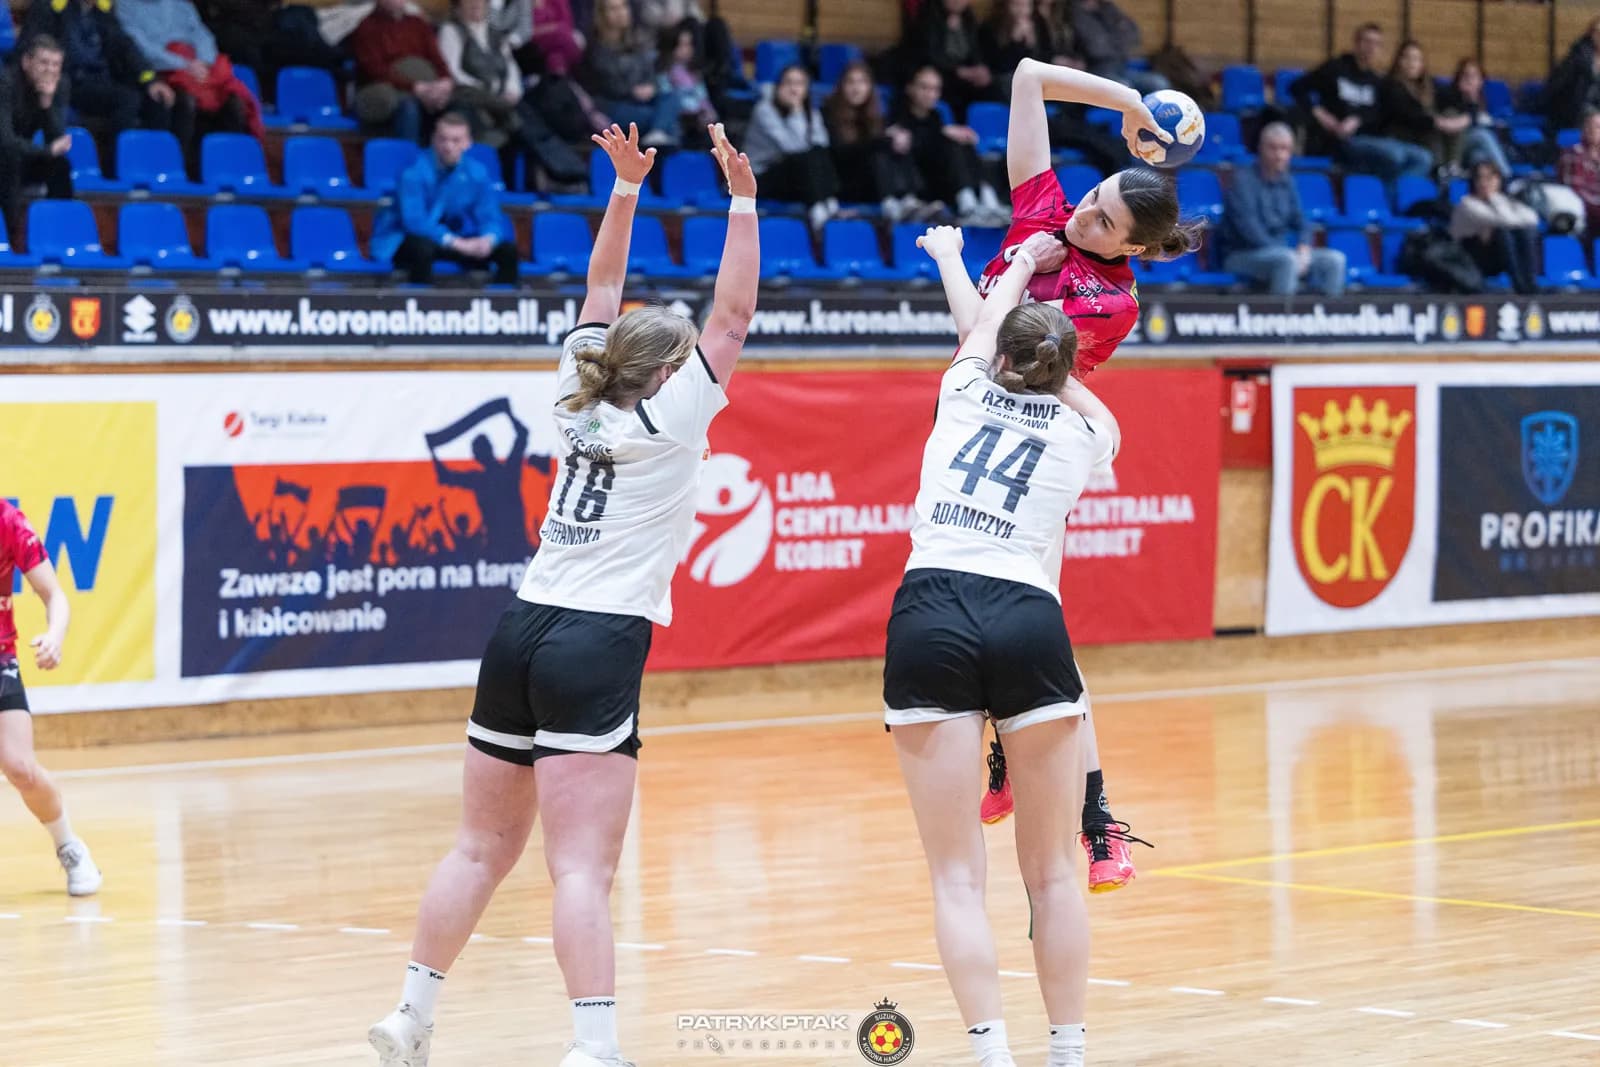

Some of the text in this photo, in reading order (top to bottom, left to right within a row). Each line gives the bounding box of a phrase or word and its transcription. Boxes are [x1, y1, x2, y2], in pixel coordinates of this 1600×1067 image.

[208, 297, 577, 344] www.koronahandball.pl
[1174, 303, 1437, 343] www.koronahandball.pl
[981, 389, 1060, 421] AZS AWF
[556, 450, 616, 523] 16
[776, 471, 836, 503] LIGA
[949, 424, 1047, 514] 44
[931, 502, 1016, 539] ADAMCZYK
[1301, 473, 1394, 584] CK
[775, 538, 865, 571] KOBIET
[219, 567, 322, 598] Zawsze
[325, 563, 374, 599] jest
[377, 565, 437, 597] pora
[440, 564, 474, 589] na
[218, 601, 387, 639] i kibicowanie
[575, 1000, 616, 1008] Kemp
